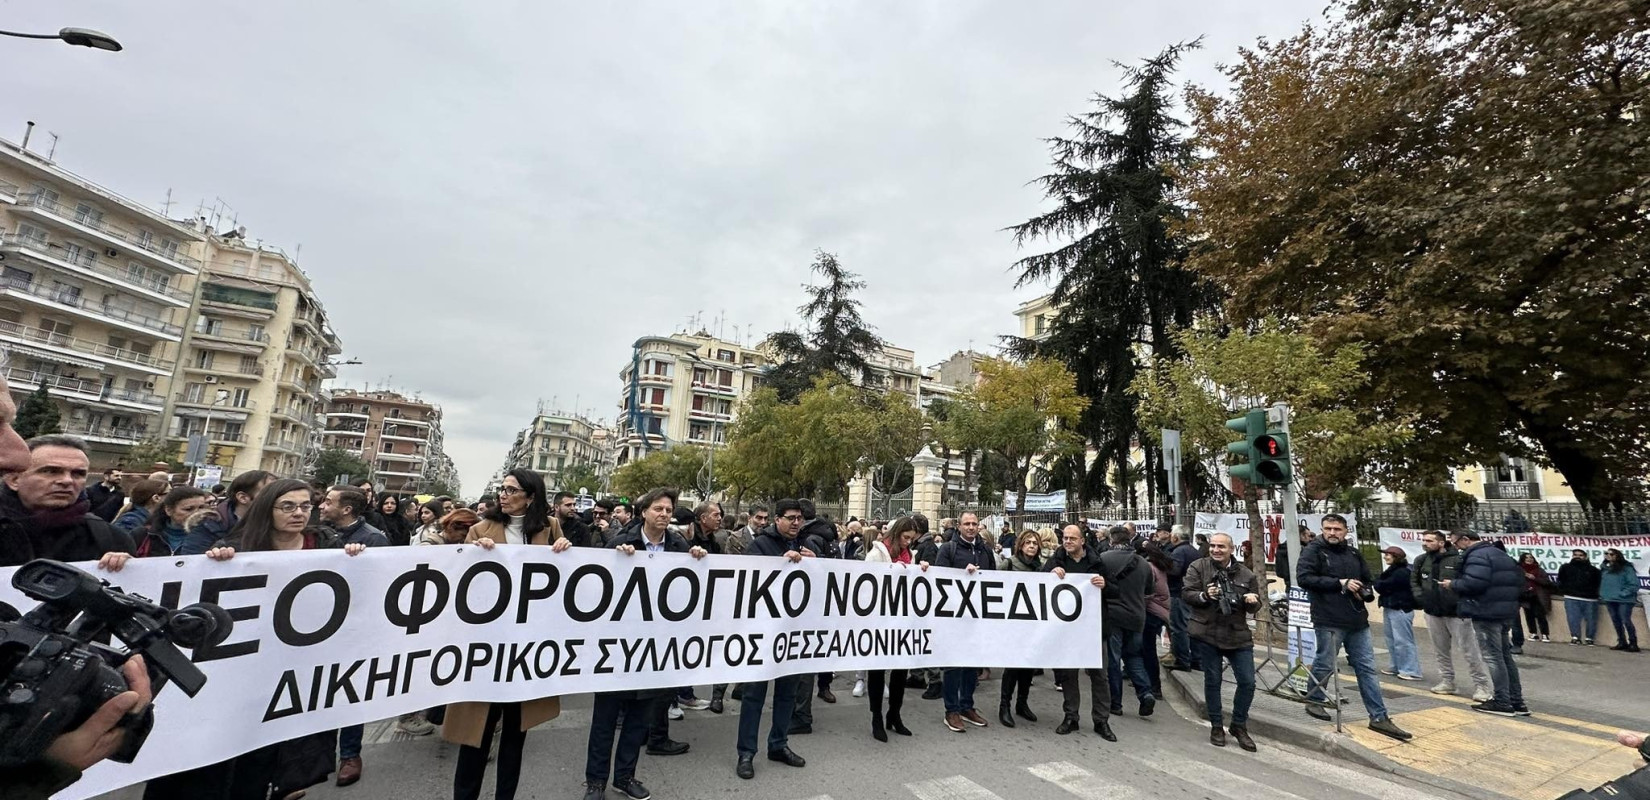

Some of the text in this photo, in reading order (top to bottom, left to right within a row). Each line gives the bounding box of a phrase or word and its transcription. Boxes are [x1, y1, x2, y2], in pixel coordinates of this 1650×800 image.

[1401, 531, 1414, 540] ΟΧΙ
[384, 561, 811, 635] ΦΟΡΟΛΟΓΙΚΟ
[823, 571, 1083, 622] ΝΟΜΟΣΧΕΔΙΟ
[261, 628, 932, 724] ΔΙΚΗΓΟΡΙΚΟΣ ΣΥΛΛΟΓΟΣ ΘΕΣΣΑΛΟΝΙΚΗΣ
